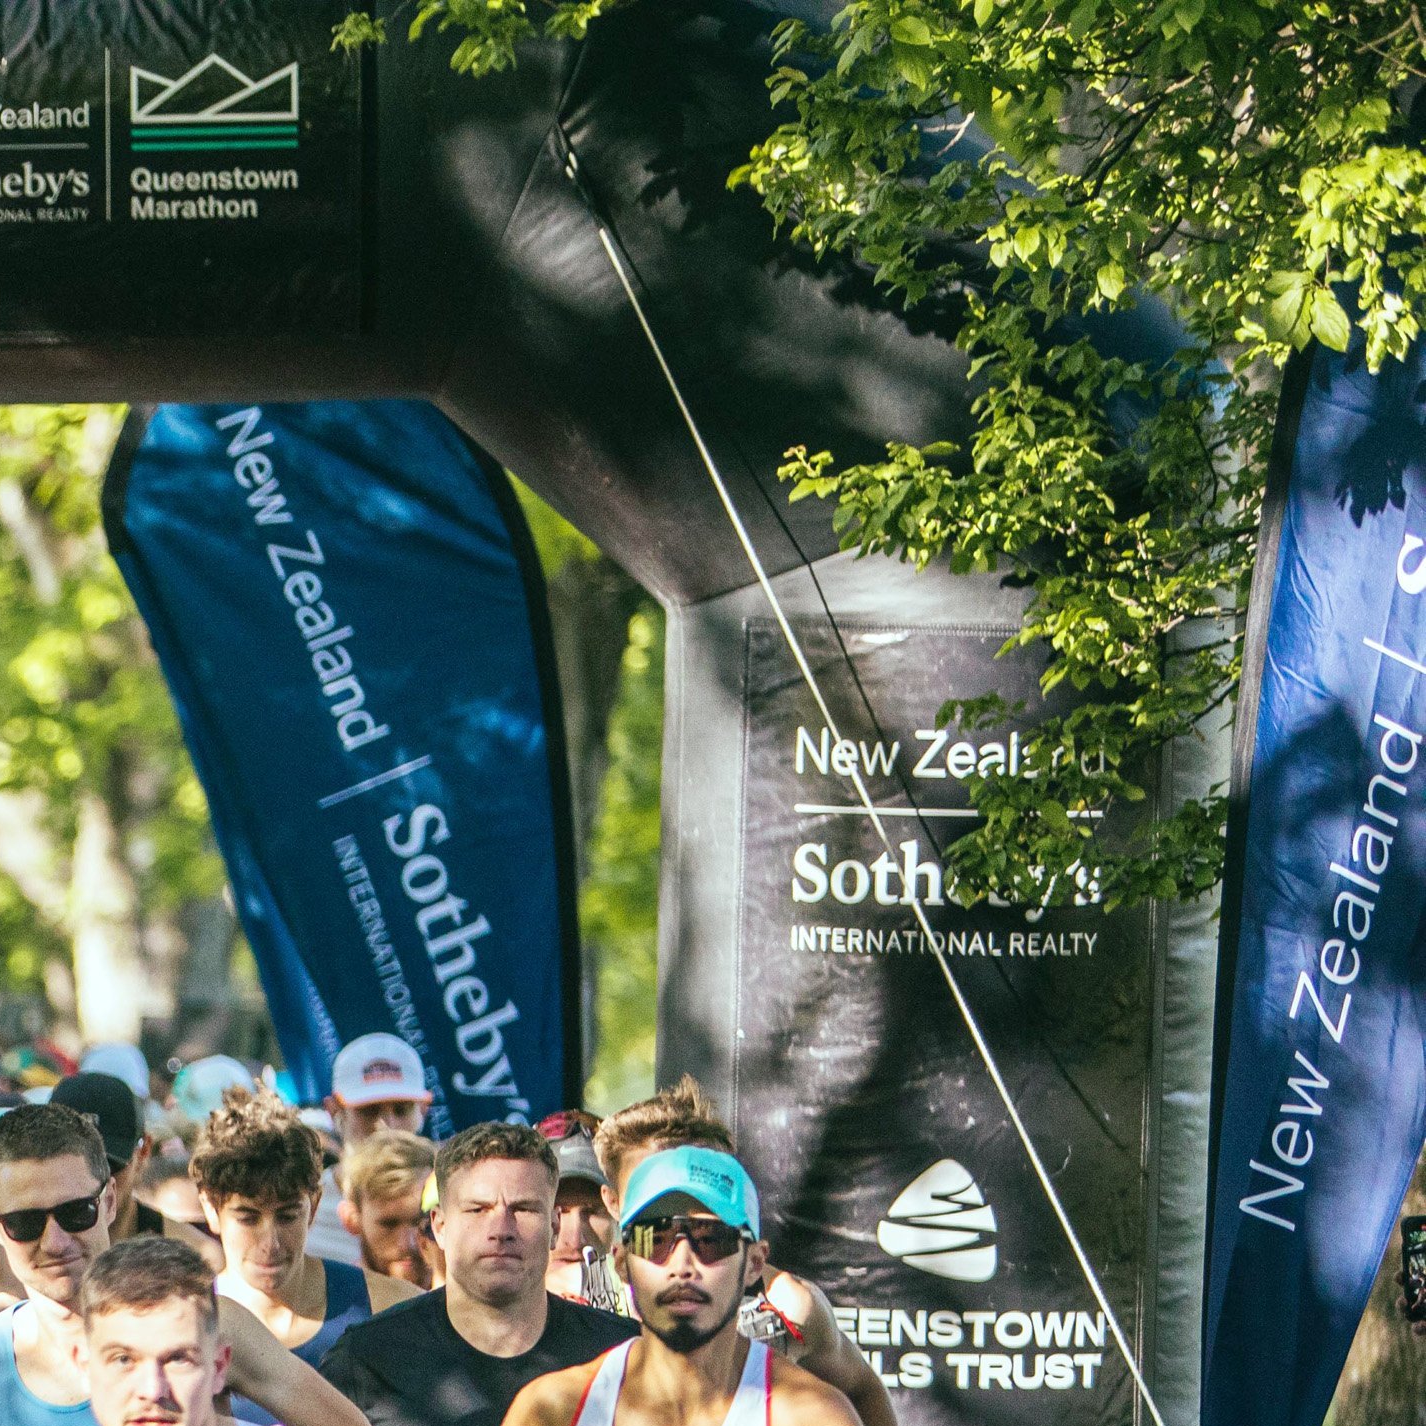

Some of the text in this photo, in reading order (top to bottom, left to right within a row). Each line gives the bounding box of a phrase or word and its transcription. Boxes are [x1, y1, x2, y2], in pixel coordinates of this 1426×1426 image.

[131, 166, 298, 193] Queenstown
[36, 207, 89, 222] REALTY
[131, 195, 258, 220] Marathon
[217, 407, 389, 752] New Zealand
[794, 726, 900, 777] New
[792, 840, 1101, 922] Sothy's
[790, 925, 1098, 957] INTERNATIONAL REALTY
[1238, 711, 1421, 1233] New Zealand
[832, 1307, 1105, 1349] EENSTOWN
[946, 1352, 1102, 1390] TRUST
